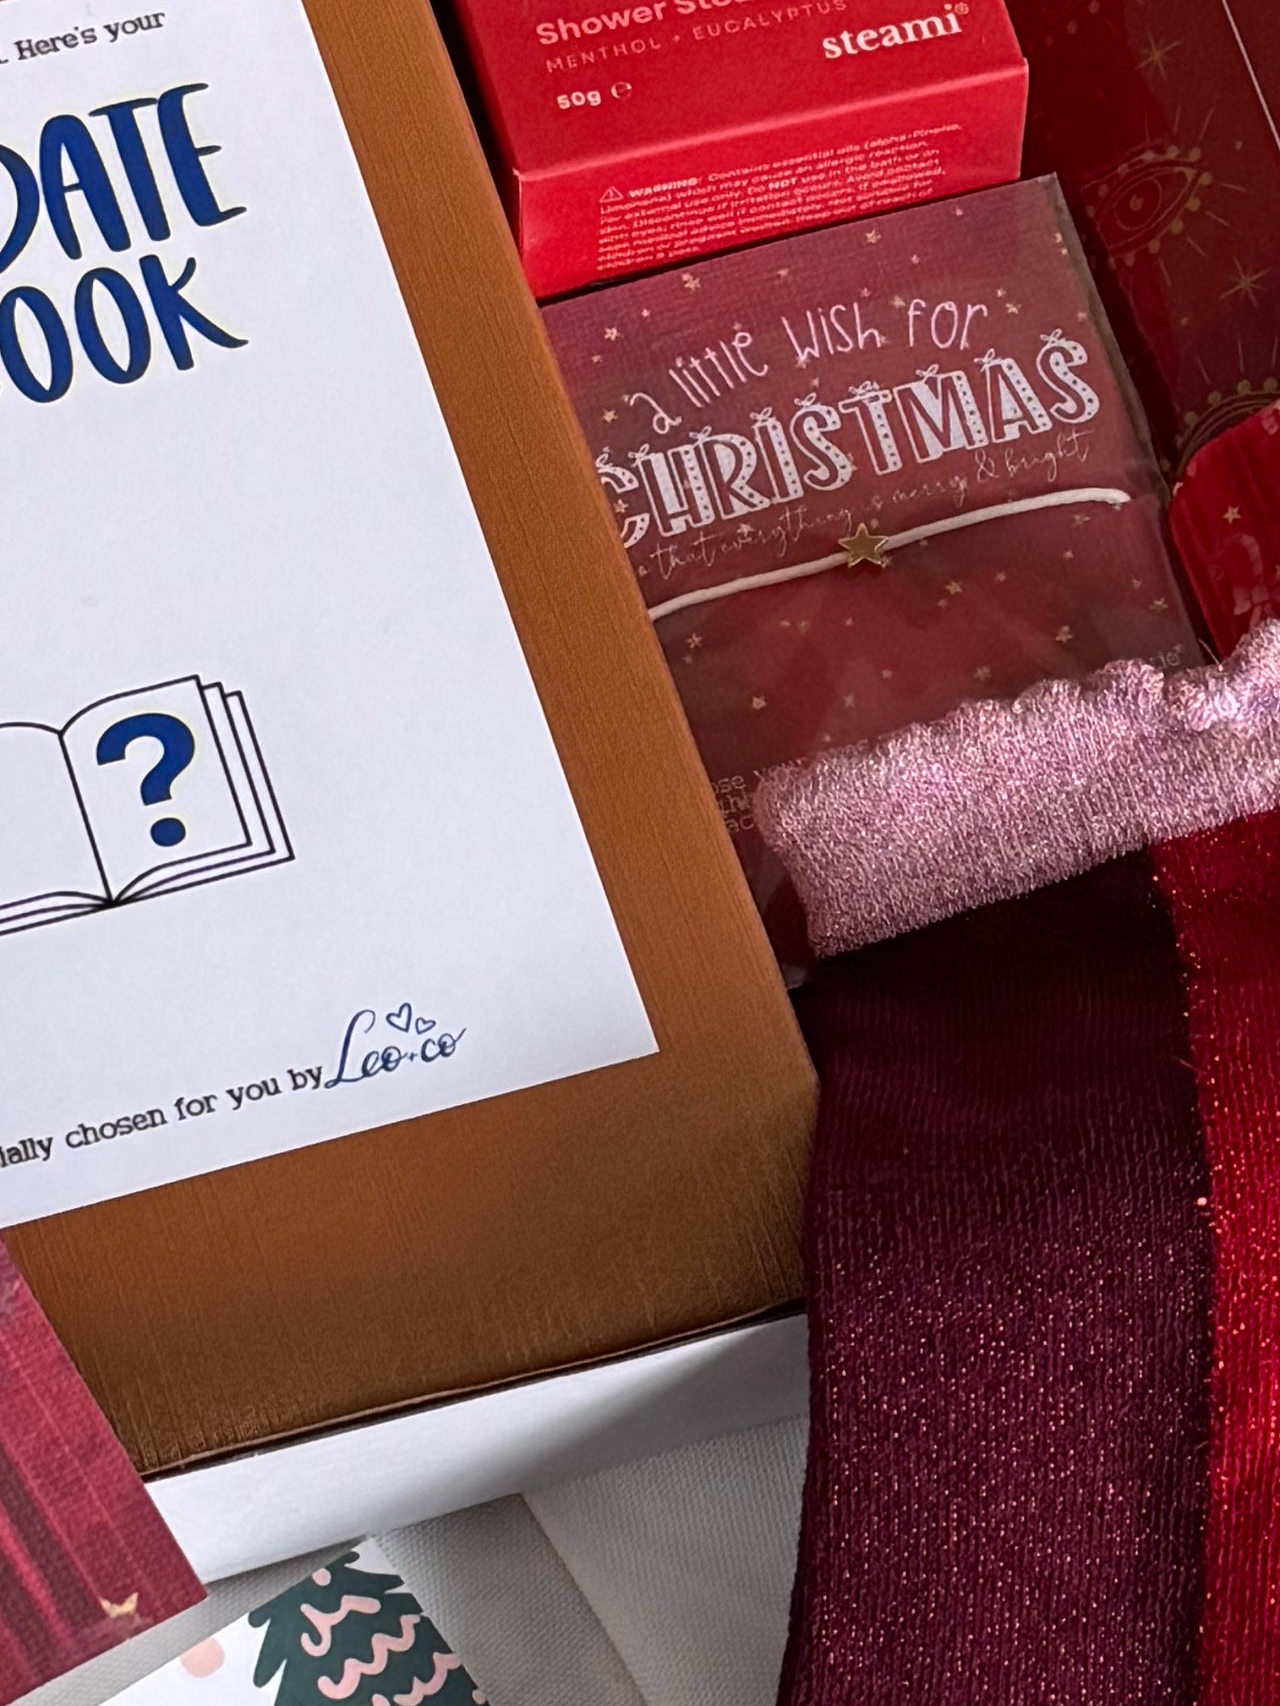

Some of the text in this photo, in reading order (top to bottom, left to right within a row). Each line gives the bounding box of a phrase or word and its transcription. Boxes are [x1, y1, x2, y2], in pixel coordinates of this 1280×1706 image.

[15, 26, 97, 60] Here's
[104, 12, 165, 43] your
[536, 0, 667, 45] Shower
[546, 36, 661, 74] MENTHOL
[557, 89, 602, 110] 50g
[629, 393, 681, 434] a
[668, 332, 768, 408] little
[1005, 429, 1096, 482] bright
[65, 1108, 167, 1148] chosen
[175, 1094, 218, 1120] for
[226, 1077, 282, 1110] you
[287, 1066, 323, 1090] by
